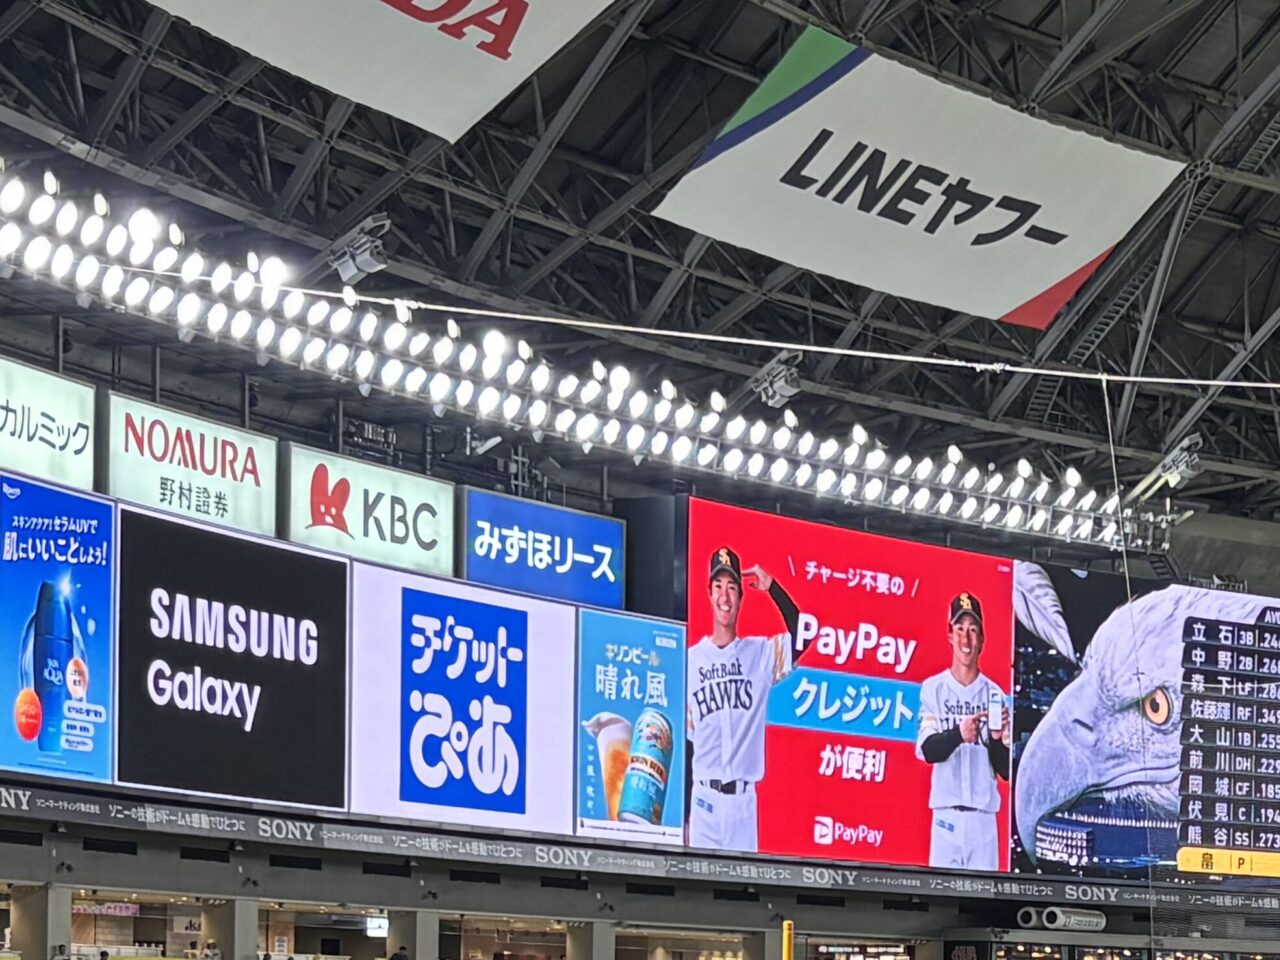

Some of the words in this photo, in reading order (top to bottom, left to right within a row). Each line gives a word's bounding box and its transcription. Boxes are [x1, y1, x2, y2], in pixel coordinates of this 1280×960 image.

[778, 127, 1070, 247] LINEヤフー
[0, 399, 89, 455] カルミック
[124, 413, 260, 487] NOMURA
[160, 476, 228, 518] 野村證券
[363, 488, 438, 552] KBC
[474, 520, 616, 583] みずほリース
[806, 562, 904, 595] チャージ不要の
[150, 588, 319, 666] SAMSUNG
[410, 611, 523, 687] チケット
[796, 612, 916, 673] PayPay
[1192, 623, 1232, 643] 立石
[1240, 630, 1254, 645] 3B
[595, 664, 668, 708] 晴れ風
[699, 658, 742, 684] SoftBank
[147, 659, 262, 732] Galaxy
[693, 680, 753, 721] HAWKS
[793, 677, 913, 729] クレジット
[409, 691, 520, 796] ぴあ
[819, 745, 885, 782] が便利
[258, 818, 315, 841] SONY
[835, 823, 883, 847] PayPay
[535, 847, 592, 866] SONY
[802, 868, 858, 886] SONY
[1065, 886, 1119, 902] SONY
